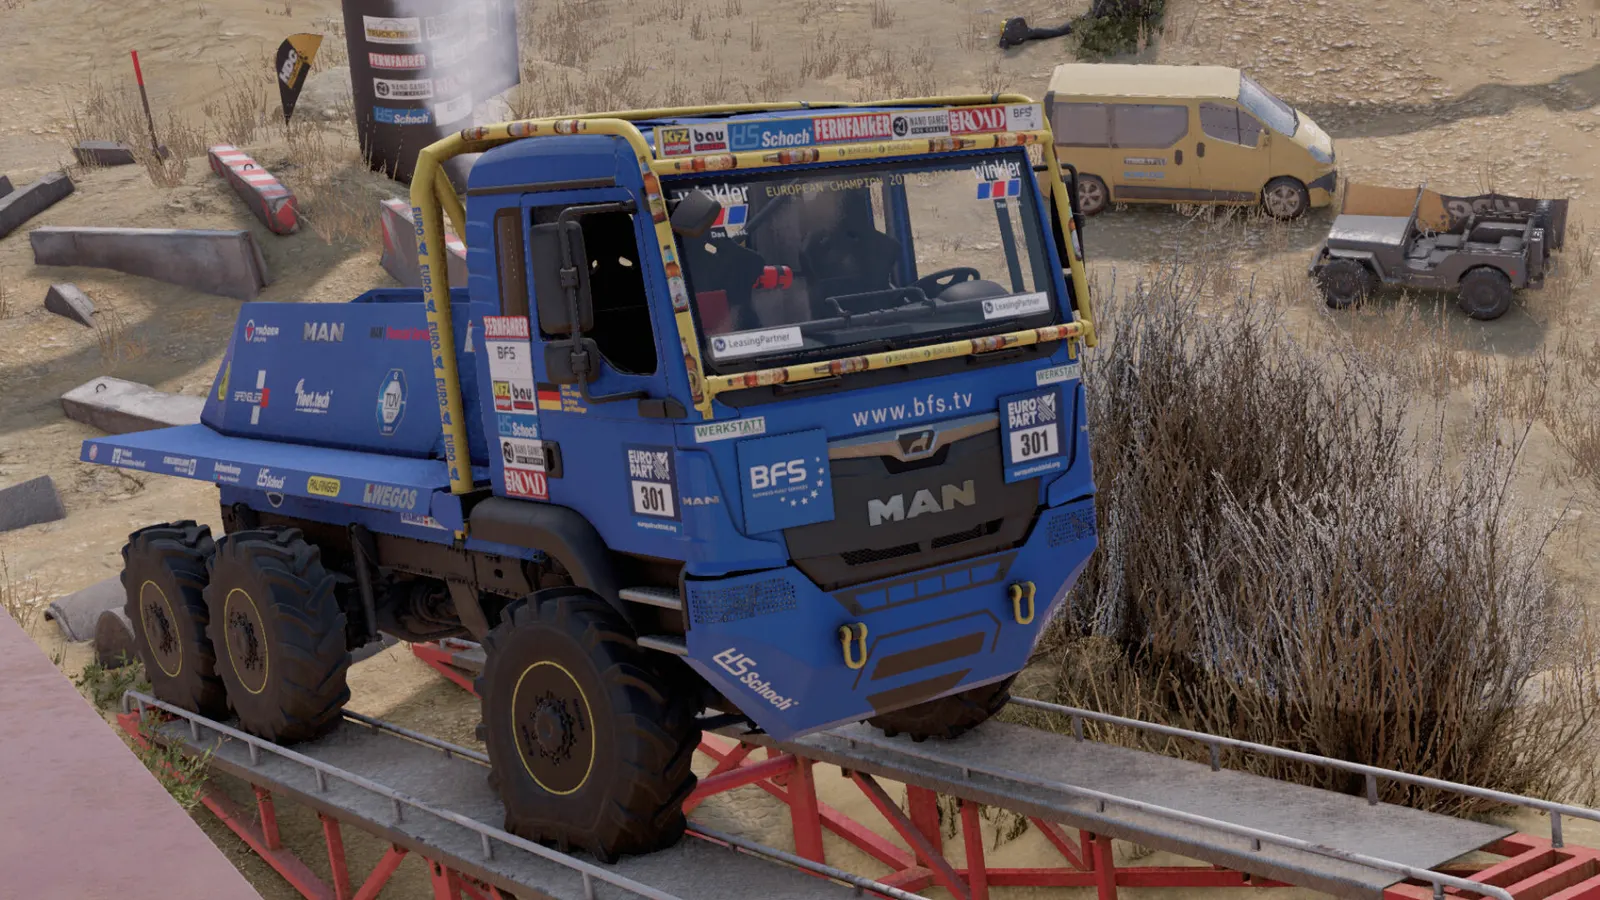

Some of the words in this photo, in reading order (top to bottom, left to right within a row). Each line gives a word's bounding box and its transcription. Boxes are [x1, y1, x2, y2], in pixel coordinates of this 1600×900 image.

[394, 112, 429, 124] Schoch
[910, 116, 926, 126] NANO
[928, 114, 949, 125] GAMES
[959, 107, 1005, 131] ROAD
[1013, 108, 1031, 118] BFS
[694, 128, 724, 143] bau
[815, 114, 891, 141] FERNFAHRER
[762, 128, 810, 147] Schoch
[971, 158, 1021, 179] winkler
[766, 182, 823, 198] EUROPEAN
[829, 176, 884, 192] CHAMPION
[412, 206, 424, 236] EURO
[710, 231, 726, 239] Das
[420, 264, 432, 294] EURO
[995, 298, 1040, 311] LeasingPartner
[304, 322, 345, 342] MAN
[428, 321, 440, 350] EURO
[728, 333, 790, 348] LeasingPartner
[497, 346, 516, 360] BFS
[436, 377, 448, 407] EURO
[512, 382, 532, 401] bau
[852, 391, 973, 428] www.bfs.tv
[1007, 400, 1036, 416] EURO
[512, 421, 538, 438] Schoch
[696, 418, 763, 437] WERKSTATT
[1009, 411, 1038, 429] PART
[1020, 429, 1049, 457] 301
[628, 449, 653, 465] EURO
[630, 463, 654, 479] PART
[750, 459, 807, 489] BFS
[511, 472, 547, 496] ROAD
[641, 486, 666, 512] 301
[682, 495, 720, 506] MAN
[868, 479, 976, 527] MAN
[712, 647, 757, 677] HS
[740, 671, 793, 711] Schoch
